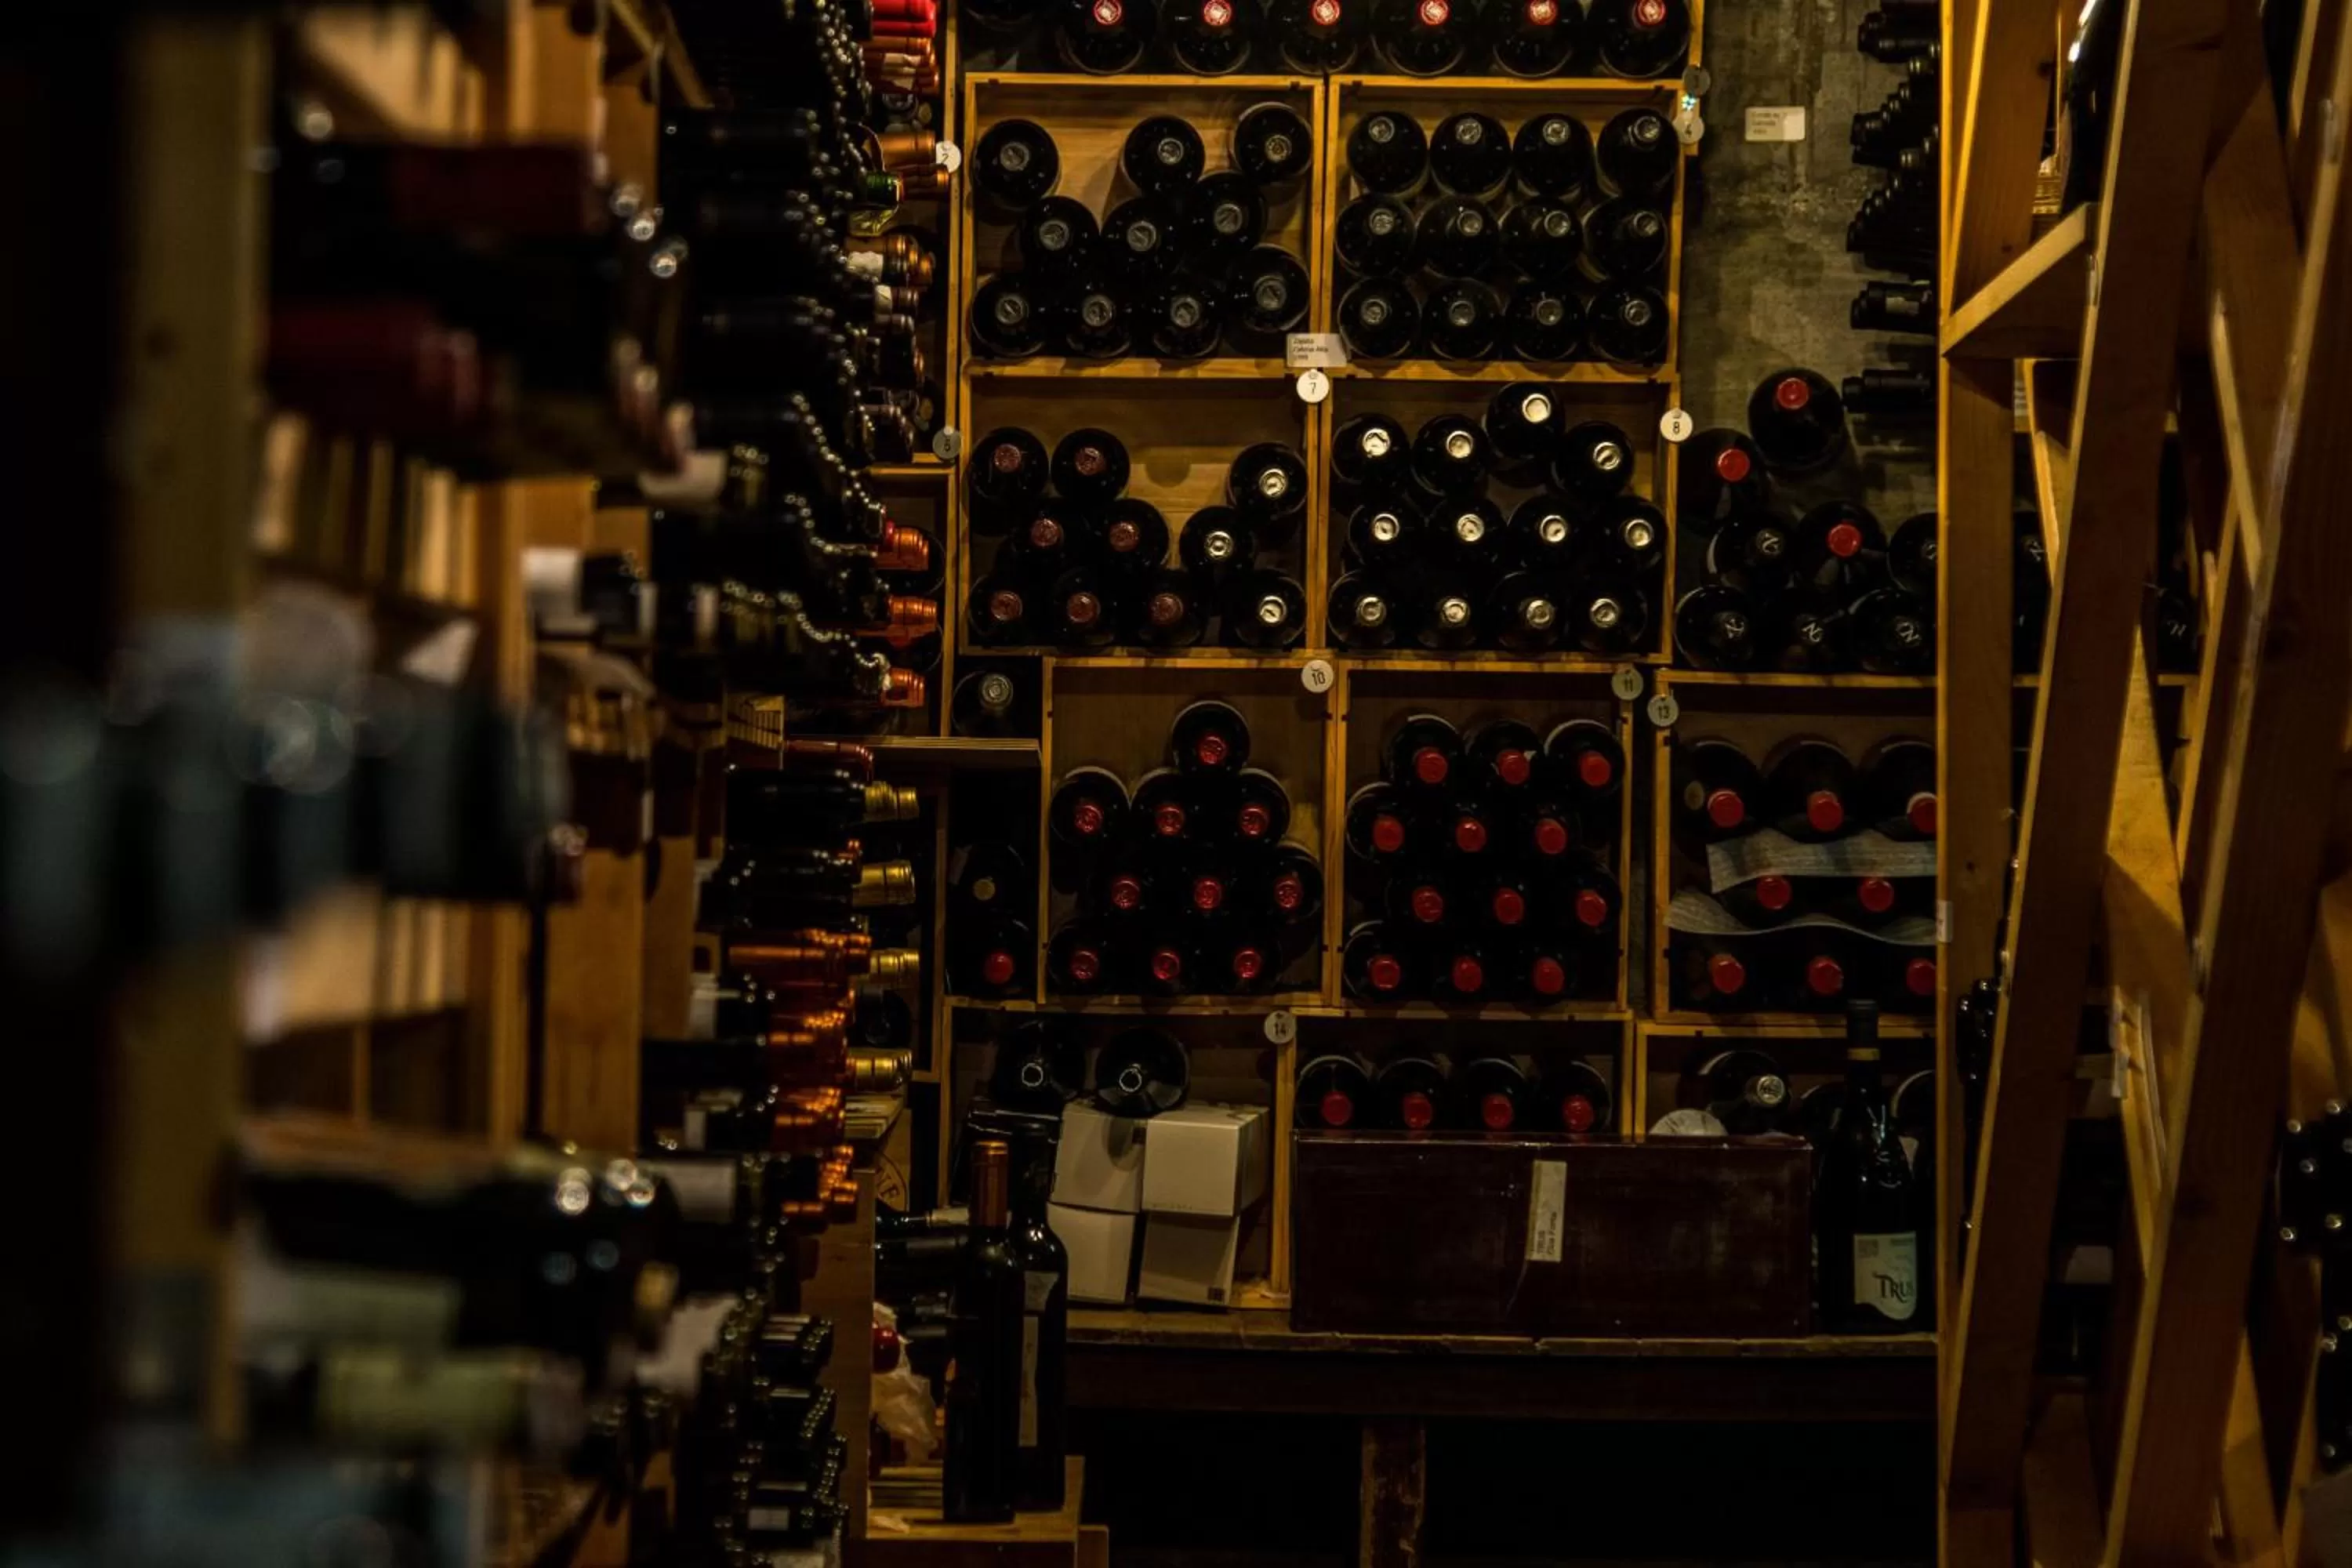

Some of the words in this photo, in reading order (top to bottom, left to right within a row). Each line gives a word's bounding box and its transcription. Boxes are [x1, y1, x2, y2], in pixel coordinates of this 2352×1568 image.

[1308, 382, 1317, 395] 7
[1672, 421, 1680, 434] 8
[1312, 670, 1326, 686] 10
[1623, 679, 1634, 692] 11
